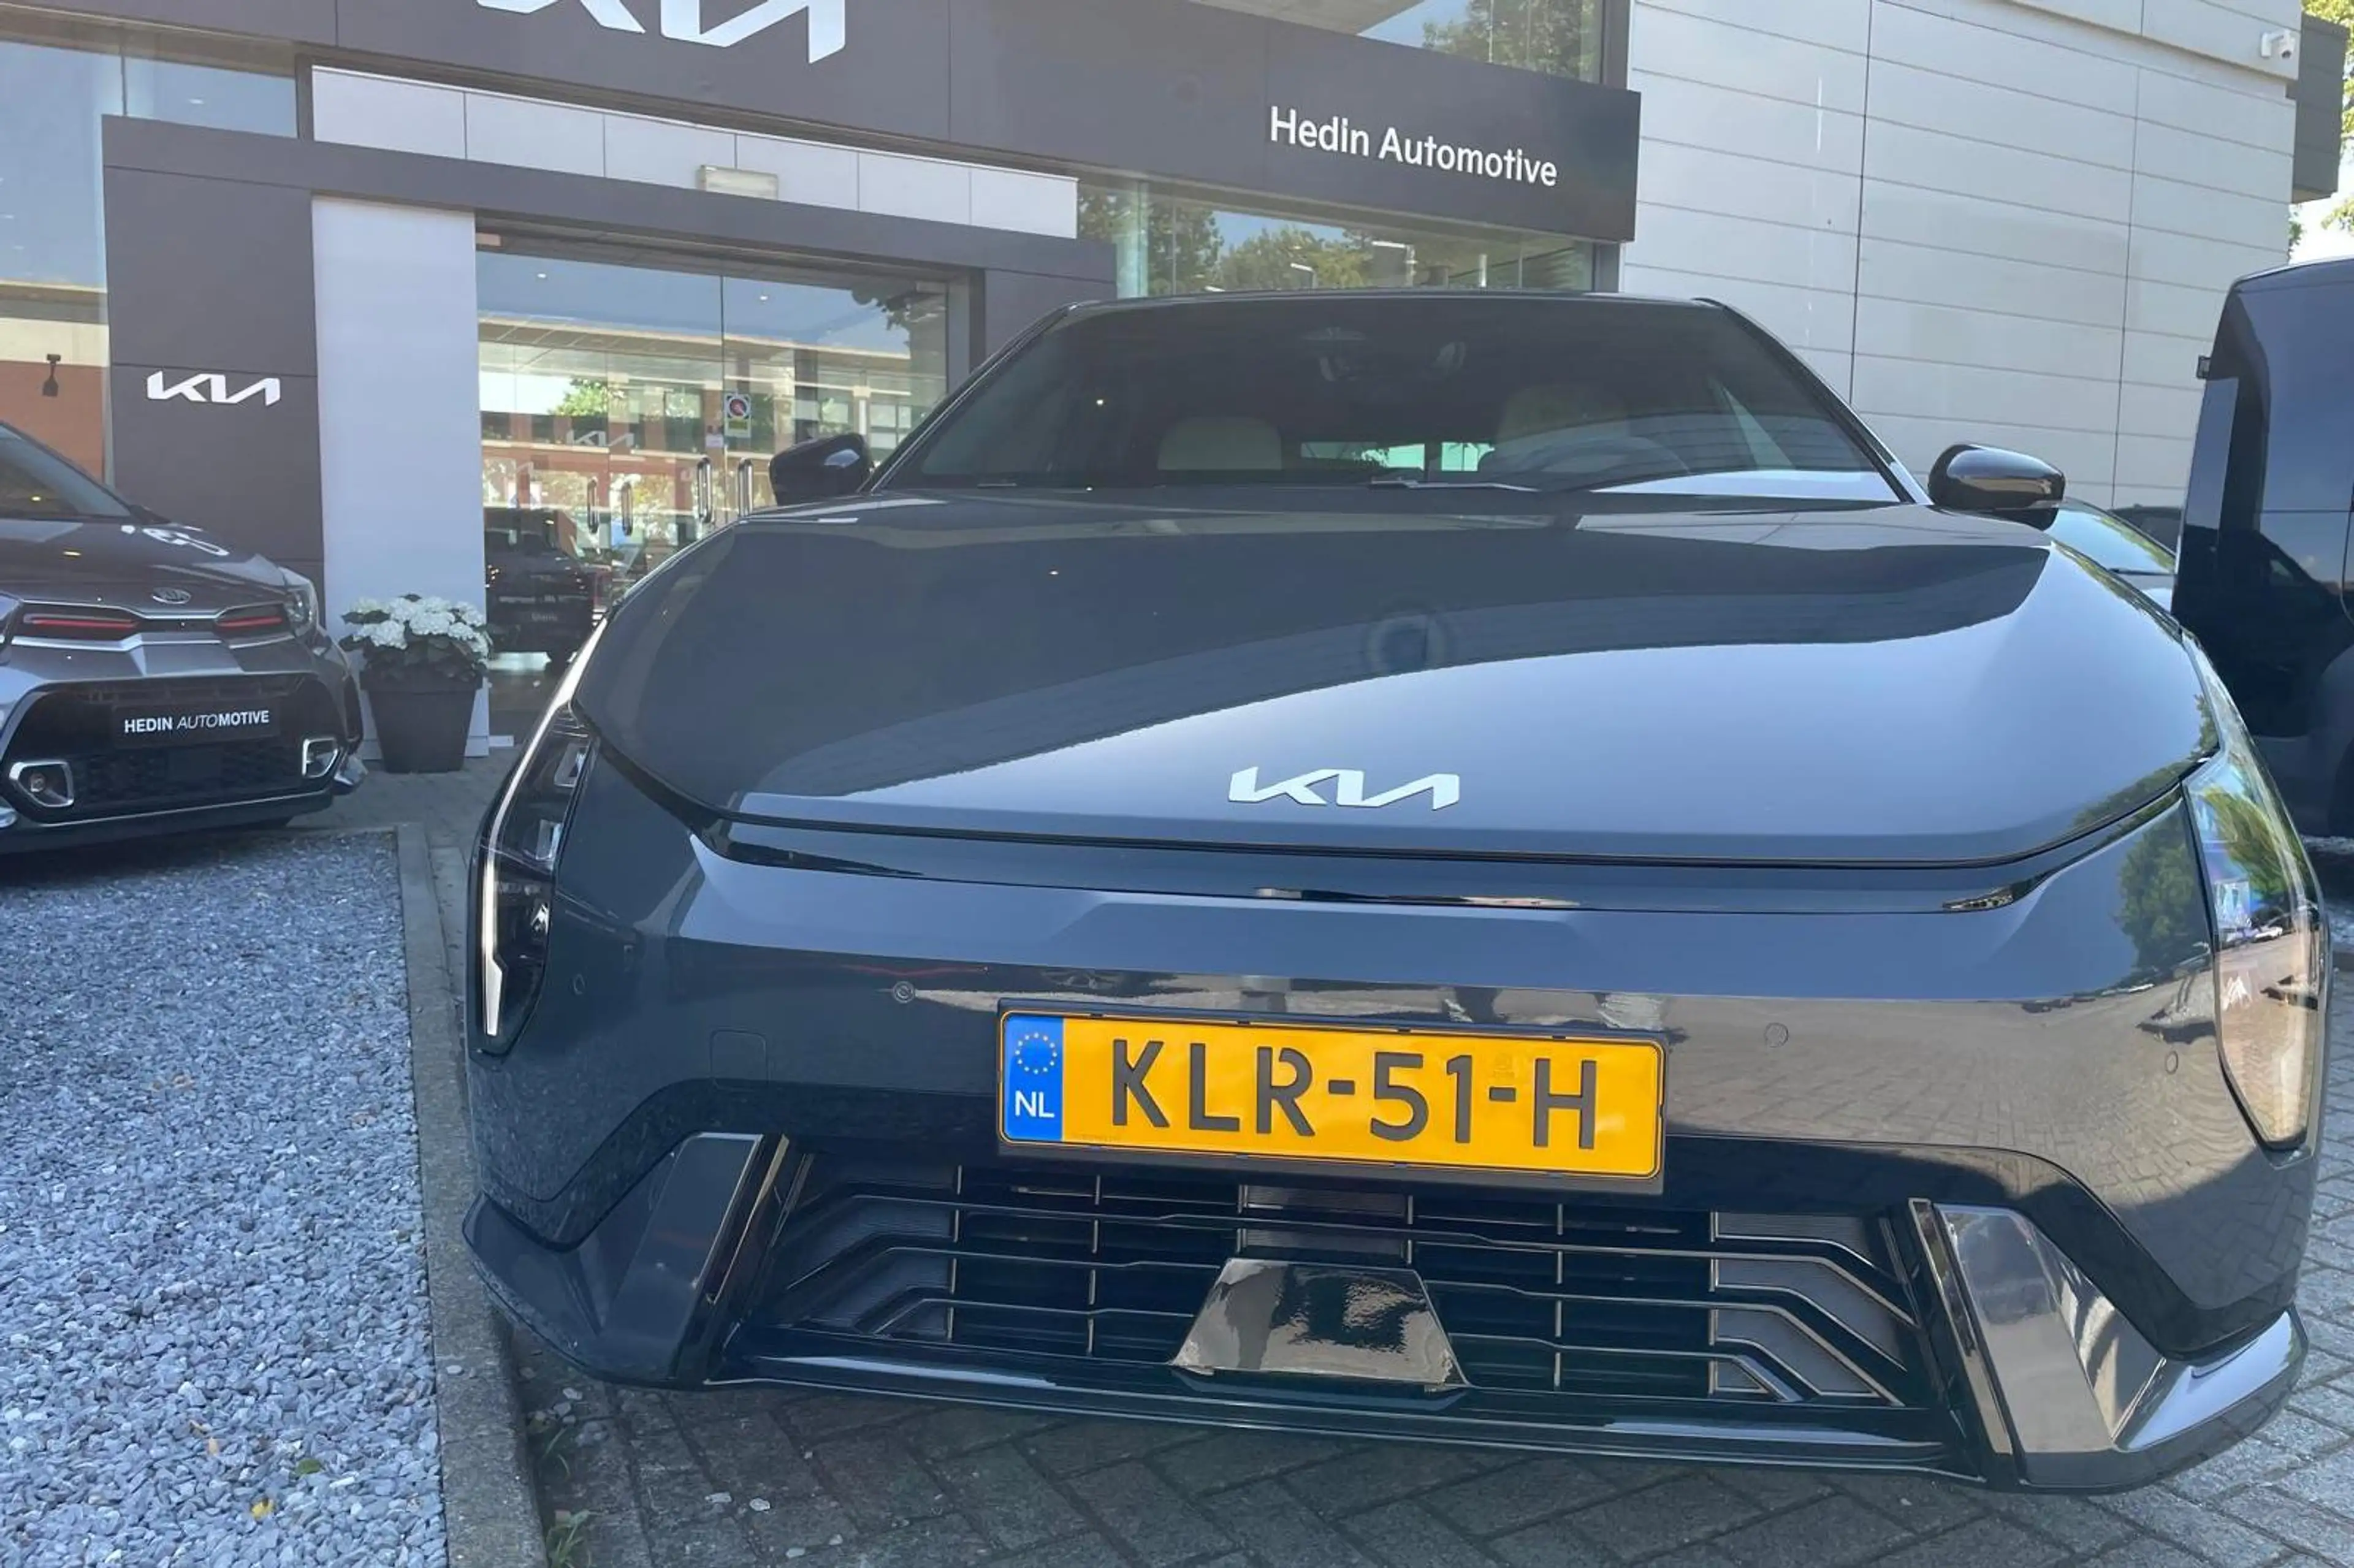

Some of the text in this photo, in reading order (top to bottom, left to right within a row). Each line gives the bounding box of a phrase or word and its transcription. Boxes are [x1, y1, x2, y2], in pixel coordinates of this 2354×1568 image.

[1271, 105, 1558, 187] Hedin Automotive
[147, 370, 280, 406] KIA
[124, 710, 270, 734] HEDIN AUTOMOTIVE
[1228, 766, 1460, 812] KIA
[1015, 1090, 1055, 1119] NL
[1112, 1038, 1598, 1150] KLR-51-H
